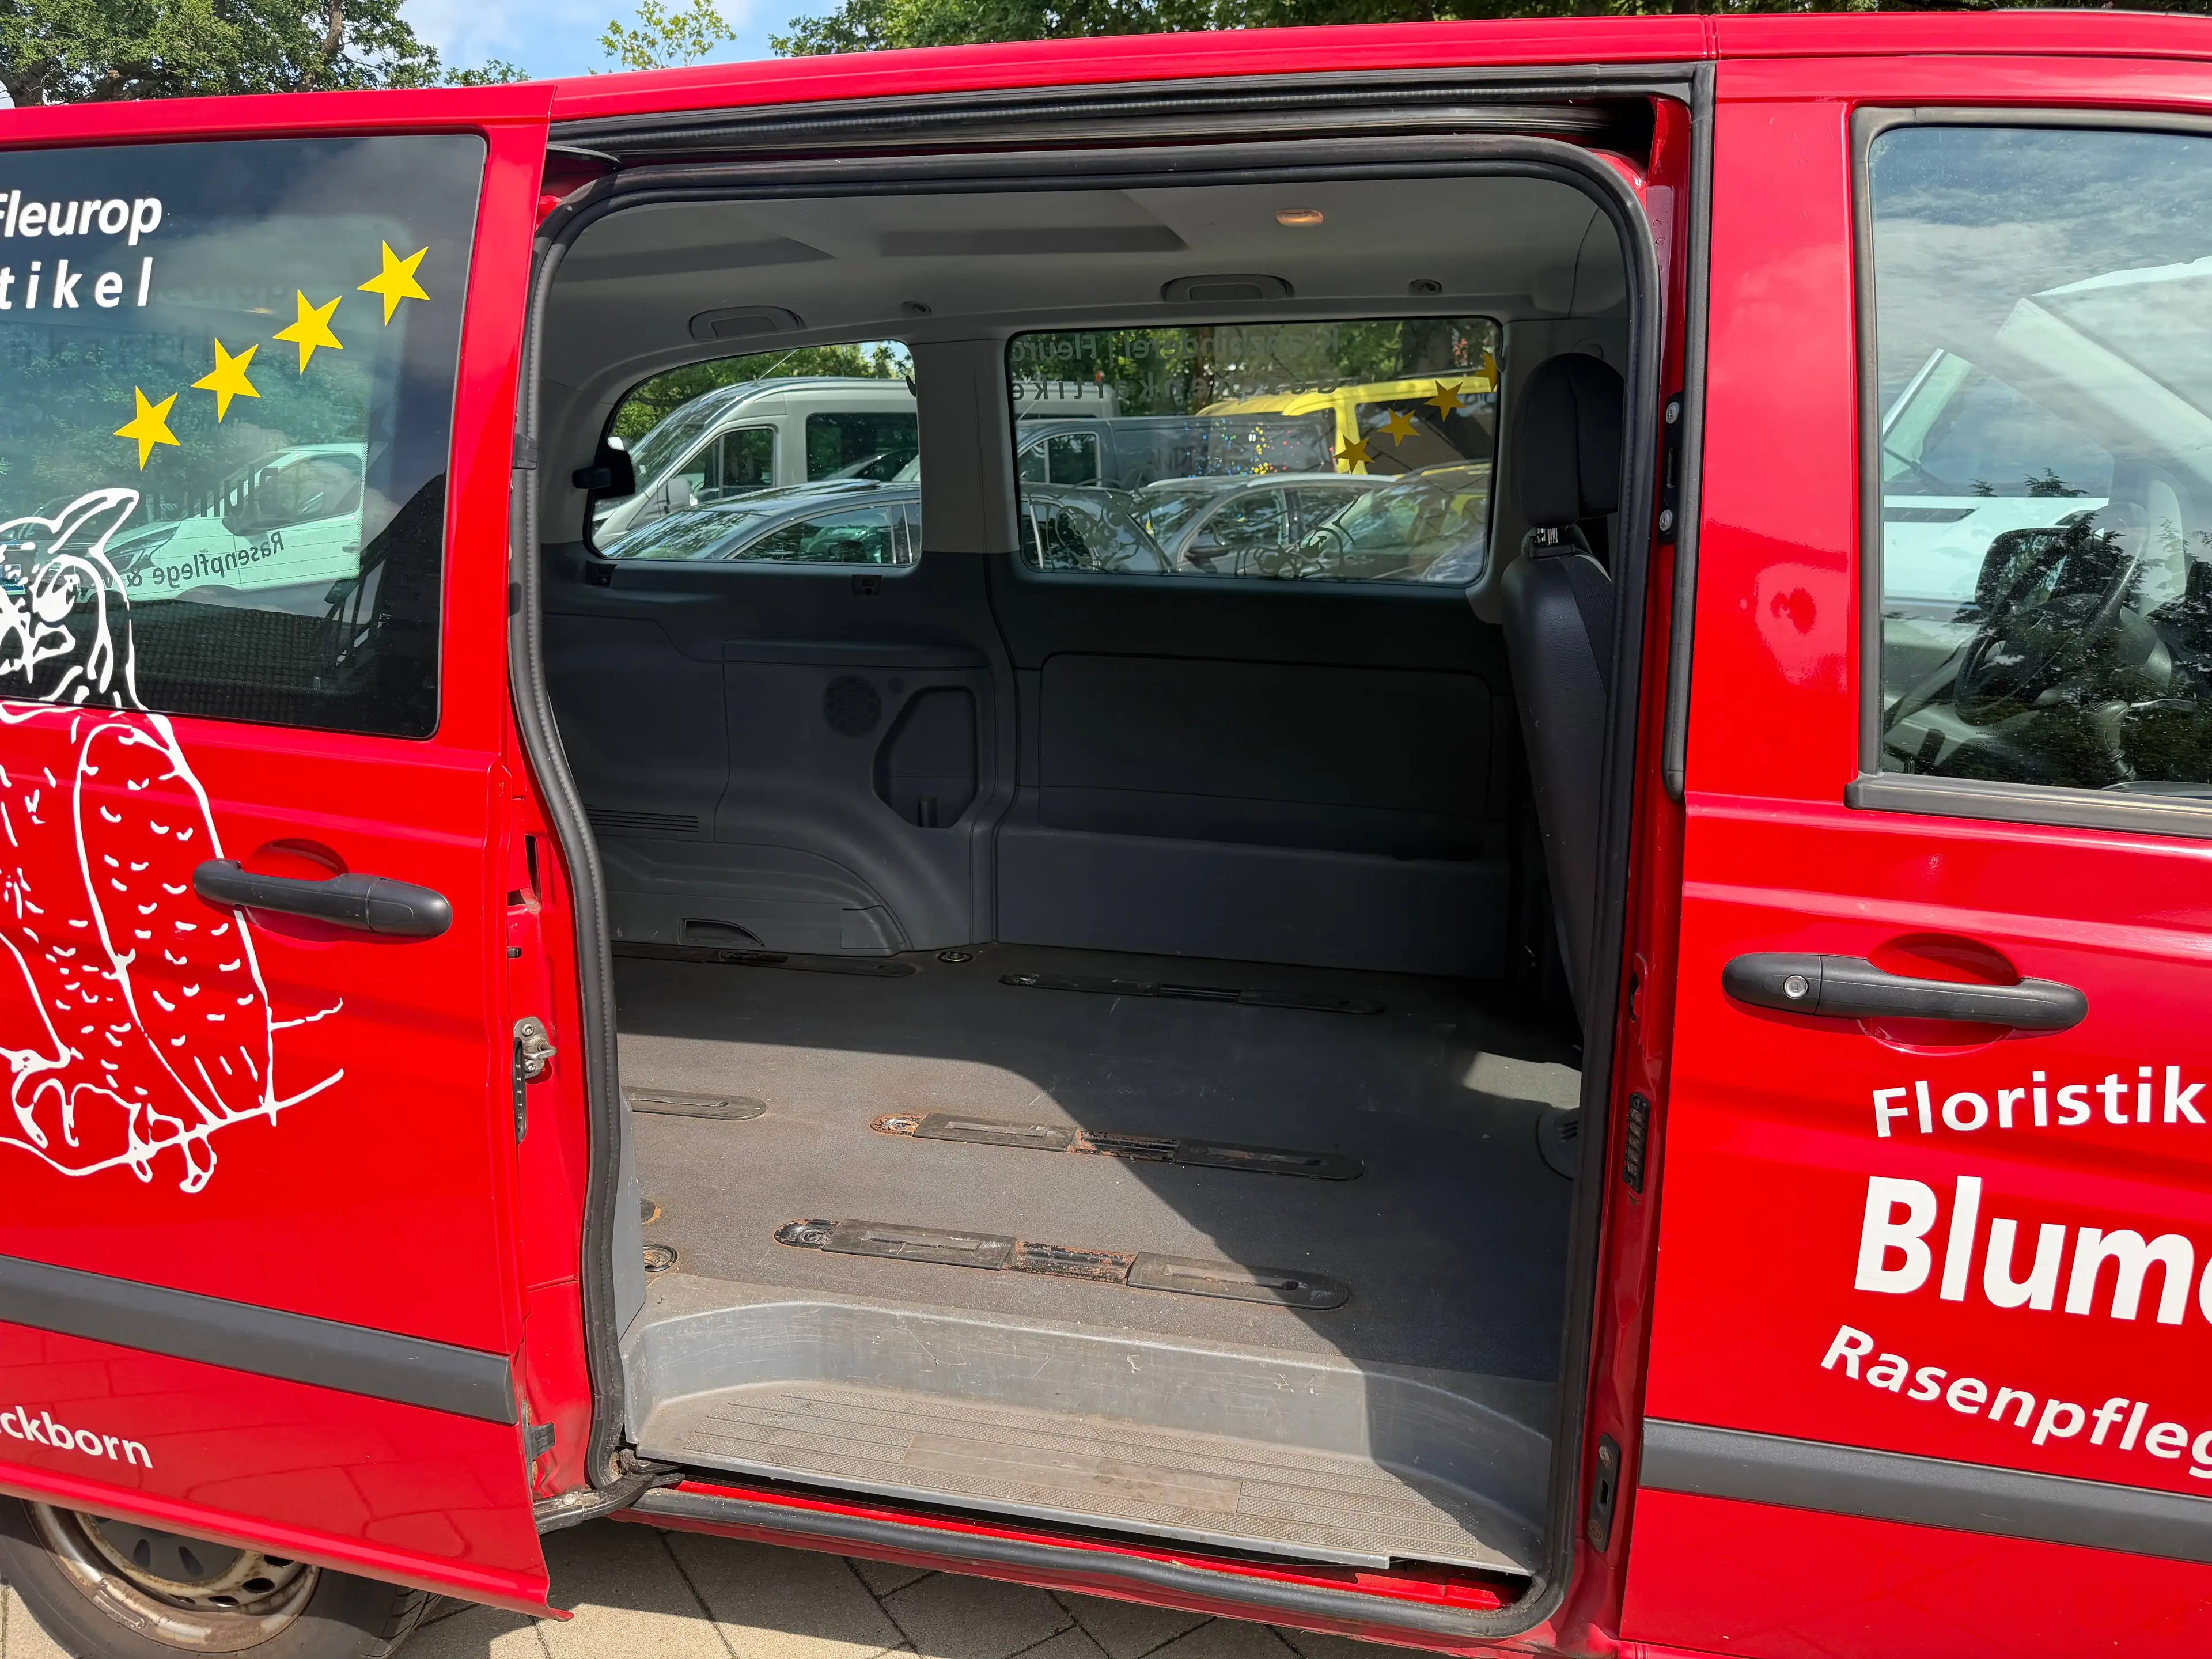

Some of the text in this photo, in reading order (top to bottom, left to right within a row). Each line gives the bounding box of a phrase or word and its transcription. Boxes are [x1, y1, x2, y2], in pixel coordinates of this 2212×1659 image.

[1872, 1065, 2207, 1138] Floristik
[1854, 1175, 2212, 1325] Blum
[0, 1405, 153, 1469] ckborn
